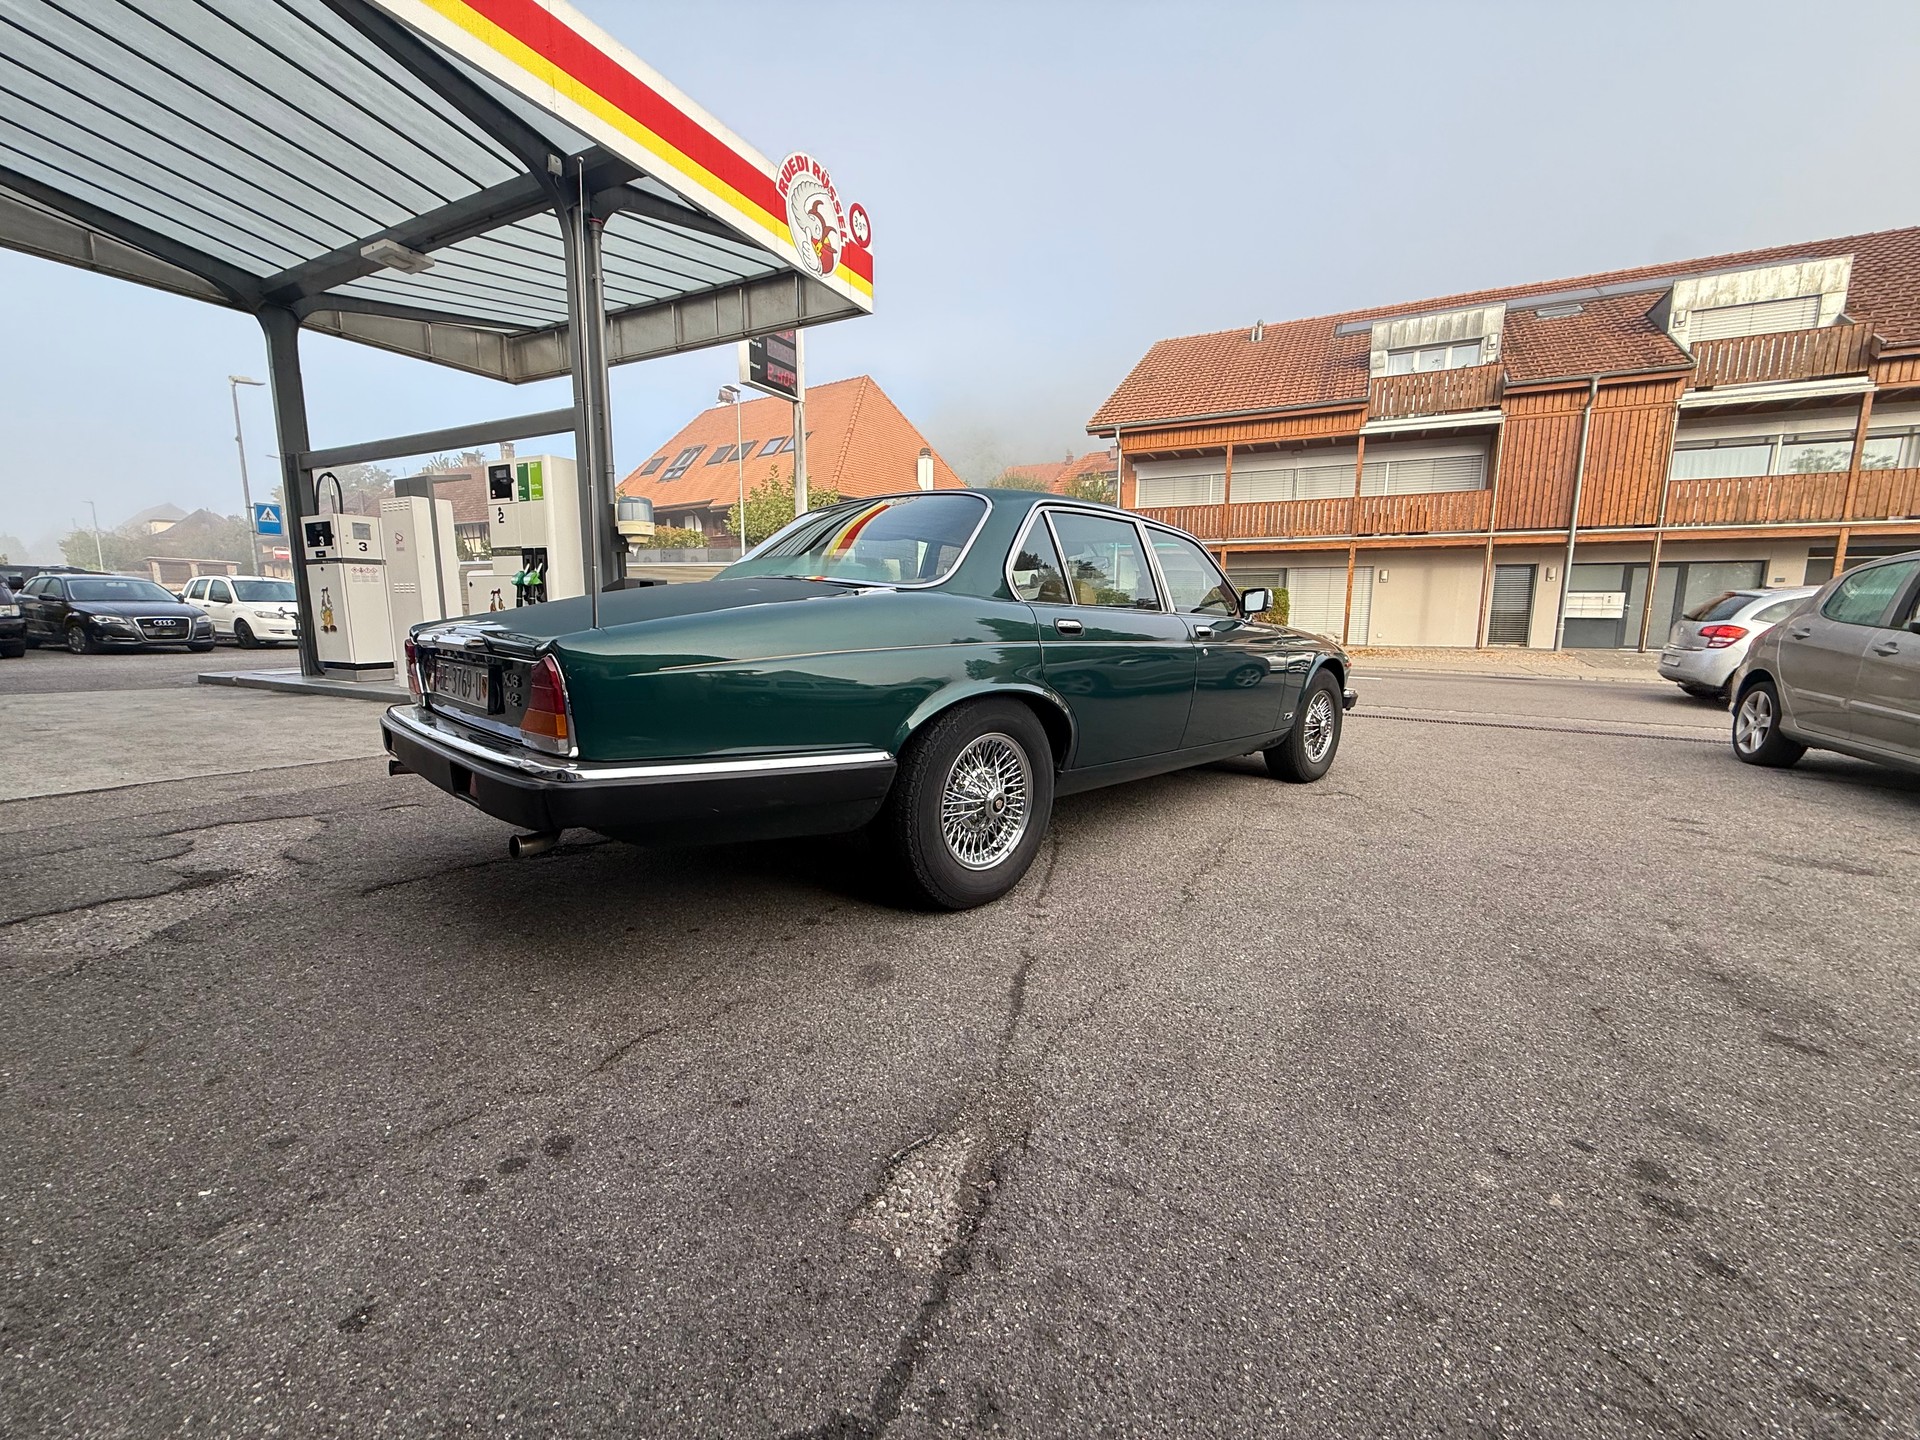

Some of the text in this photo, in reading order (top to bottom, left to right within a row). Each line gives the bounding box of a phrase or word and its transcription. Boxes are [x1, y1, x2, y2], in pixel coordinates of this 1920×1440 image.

[778, 155, 850, 247] RUEDI RÜSSEL
[498, 512, 504, 523] 2
[318, 536, 325, 546] 3
[359, 542, 368, 552] 3
